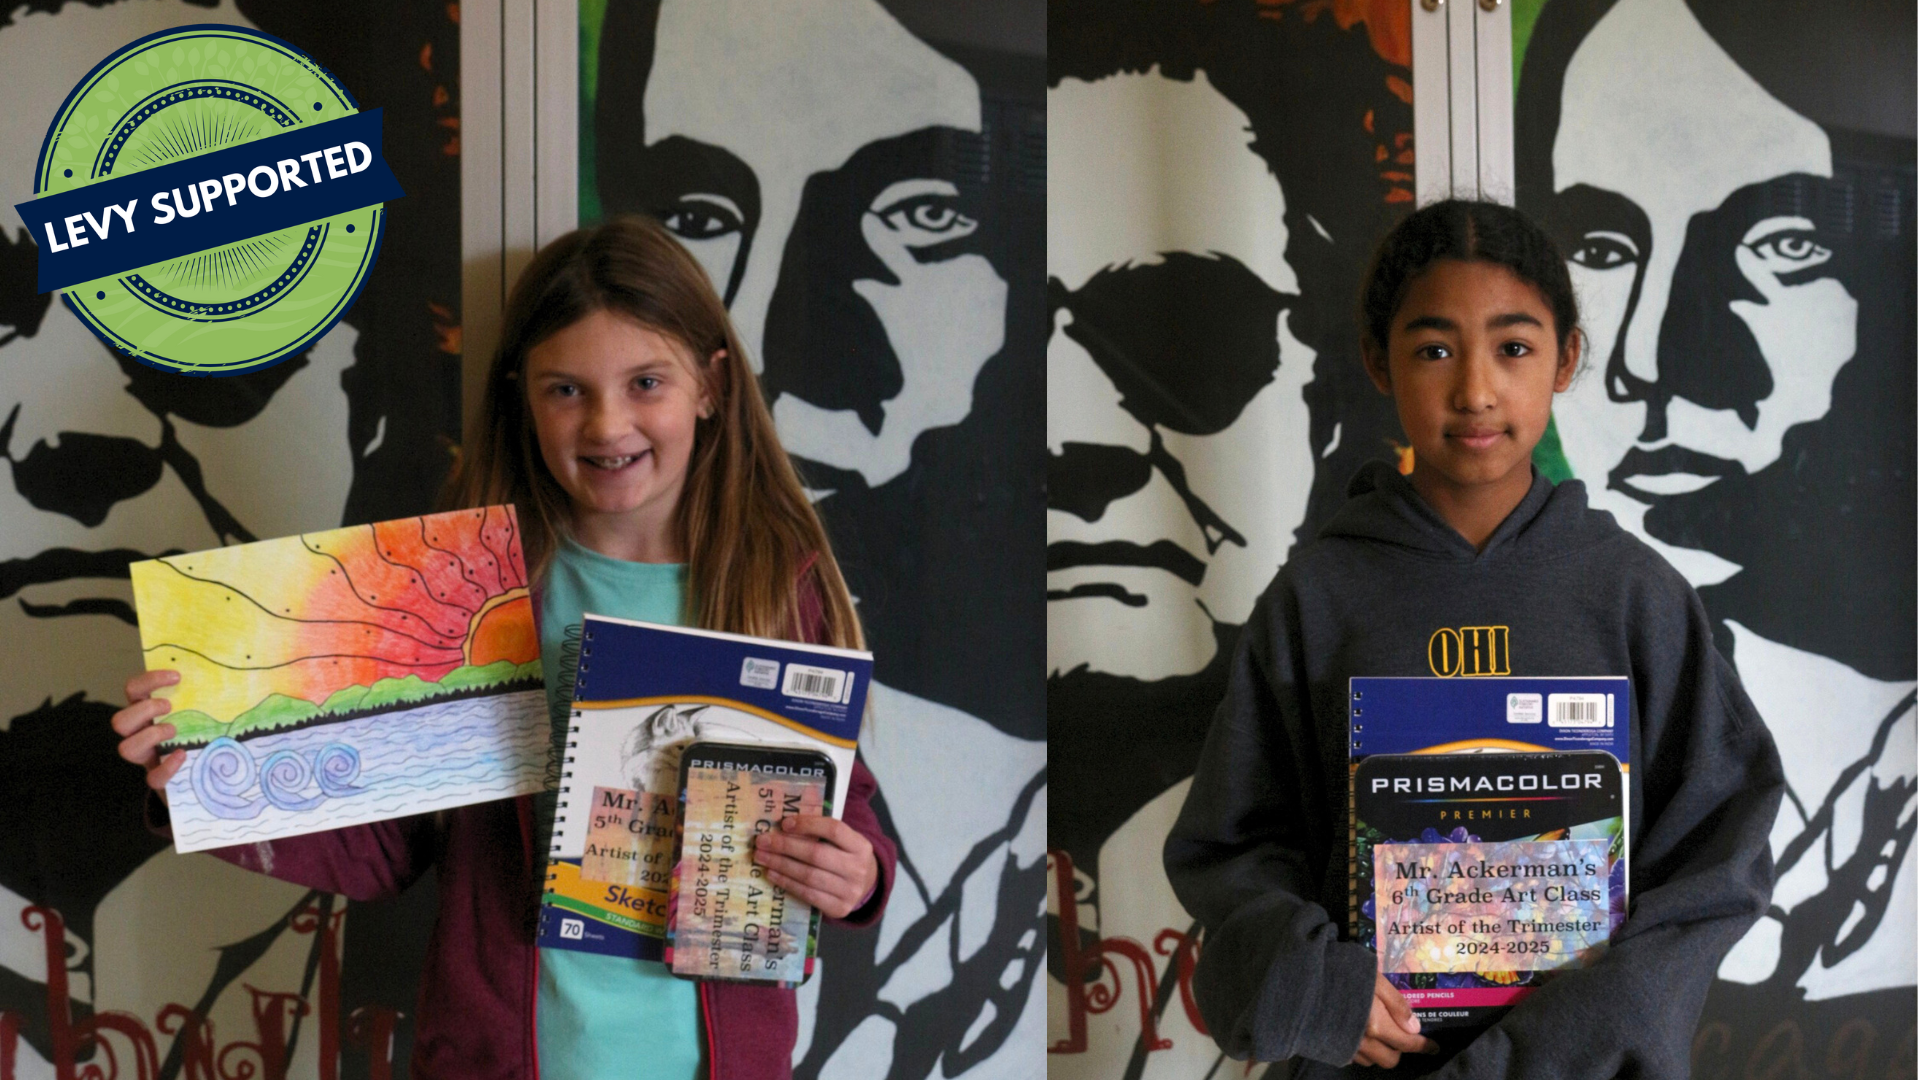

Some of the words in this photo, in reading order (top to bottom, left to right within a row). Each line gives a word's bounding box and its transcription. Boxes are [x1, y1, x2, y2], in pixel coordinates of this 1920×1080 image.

[690, 759, 825, 777] PRISMACOLOR
[1371, 774, 1603, 793] PRISMACOLOR
[602, 791, 643, 811] Mr.
[653, 799, 674, 815] A
[724, 781, 741, 830] Artist
[758, 788, 776, 813] 5th
[594, 814, 622, 830] 5th
[1440, 809, 1531, 820] PREMIER
[586, 843, 639, 861] Artist
[643, 851, 663, 865] of
[723, 835, 736, 853] of
[693, 834, 713, 916] 2024-2025
[718, 857, 733, 883] the
[1395, 862, 1438, 880] Mr.
[1447, 858, 1597, 879] Ackerman's
[746, 885, 763, 916] Art
[1392, 885, 1419, 905] 6th
[1426, 887, 1493, 904] Grade
[1501, 887, 1537, 903] Art
[1544, 886, 1601, 902] Class
[564, 923, 580, 936] 70
[605, 912, 654, 932] STANDARD
[709, 889, 730, 969] Trimester
[765, 885, 786, 971] erman's
[1387, 921, 1446, 935] Artist
[1447, 920, 1467, 934] of
[1473, 919, 1501, 933] the
[1507, 919, 1602, 933] Trimester
[740, 922, 759, 972] Class
[1456, 941, 1550, 955] 2024-2025
